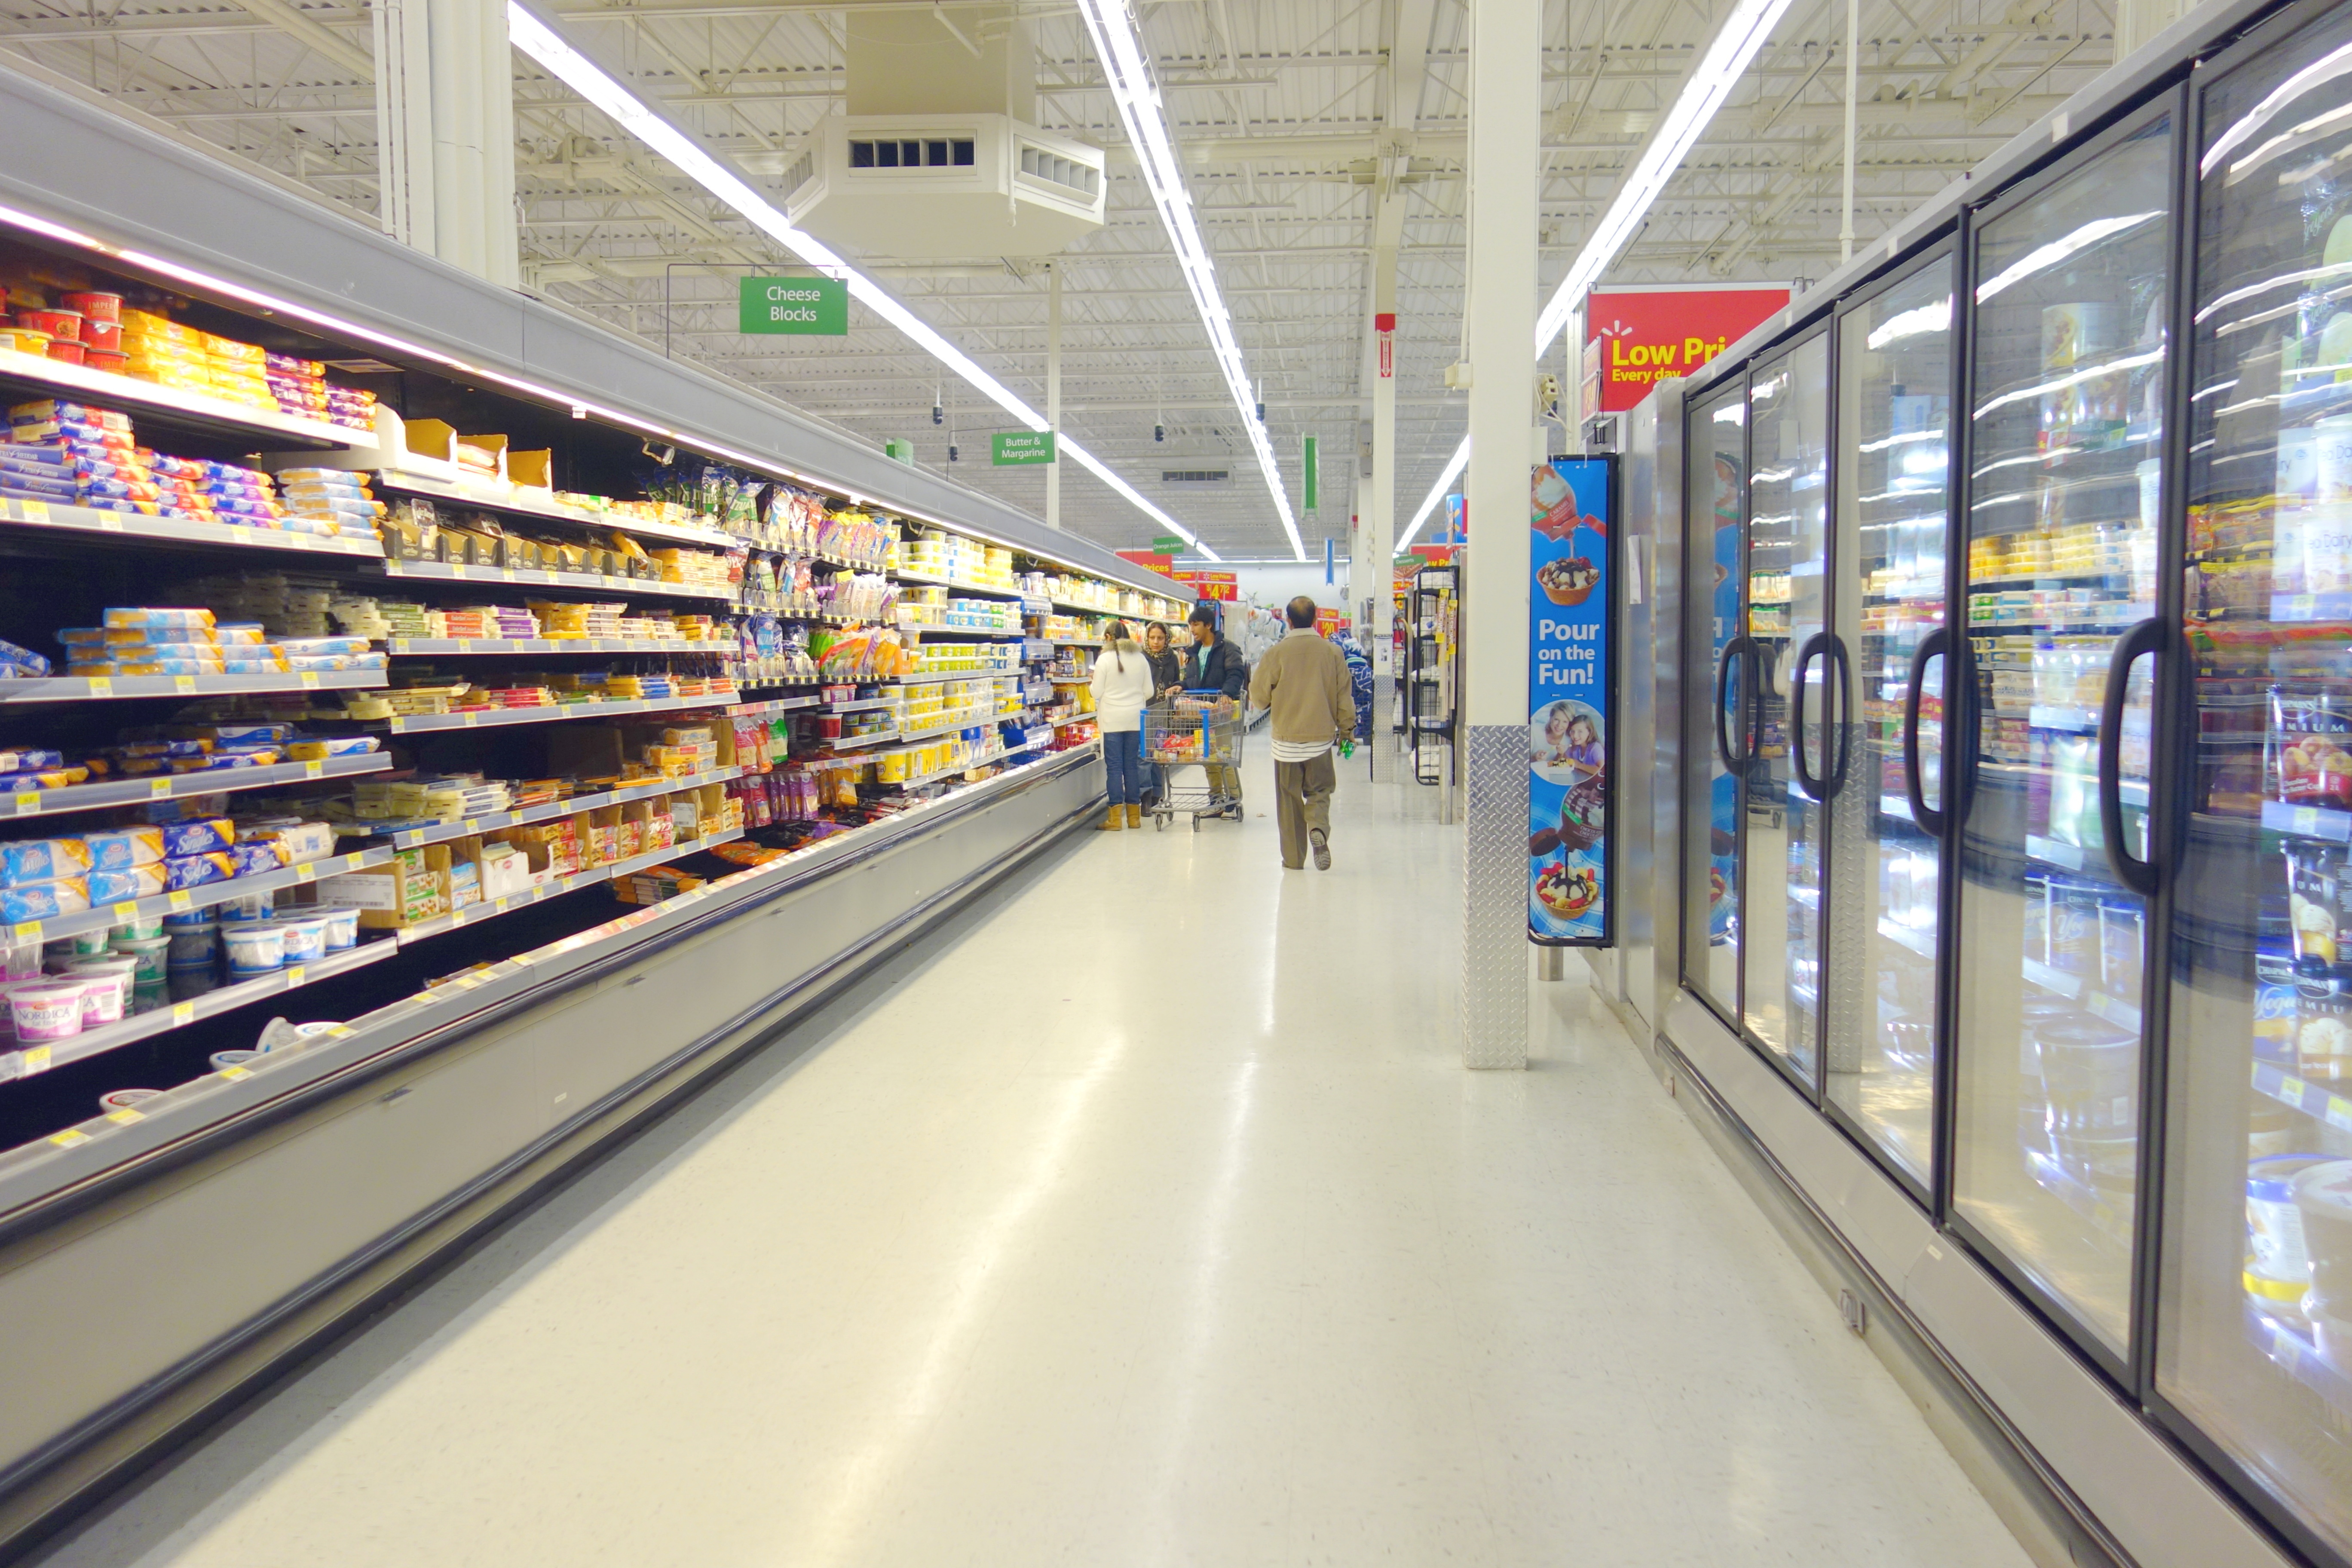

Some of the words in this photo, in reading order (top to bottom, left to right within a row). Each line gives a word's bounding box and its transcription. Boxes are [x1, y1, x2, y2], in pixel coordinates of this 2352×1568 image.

[767, 286, 821, 301] Cheese
[770, 306, 817, 321] Blocks
[1612, 340, 1676, 366] Low
[1612, 369, 1651, 384] Every
[1654, 368, 1681, 380] day
[1006, 438, 1032, 447] Butter
[1034, 437, 1040, 445] &
[1002, 448, 1045, 459] Margarine
[1550, 500, 1569, 517] CARAMEL
[1539, 619, 1599, 640] Pour
[1538, 648, 1561, 660] on
[1565, 644, 1595, 660] the
[1539, 663, 1593, 684] Fun!
[177, 828, 214, 854] Singles
[18, 1007, 70, 1020] NORDICA
